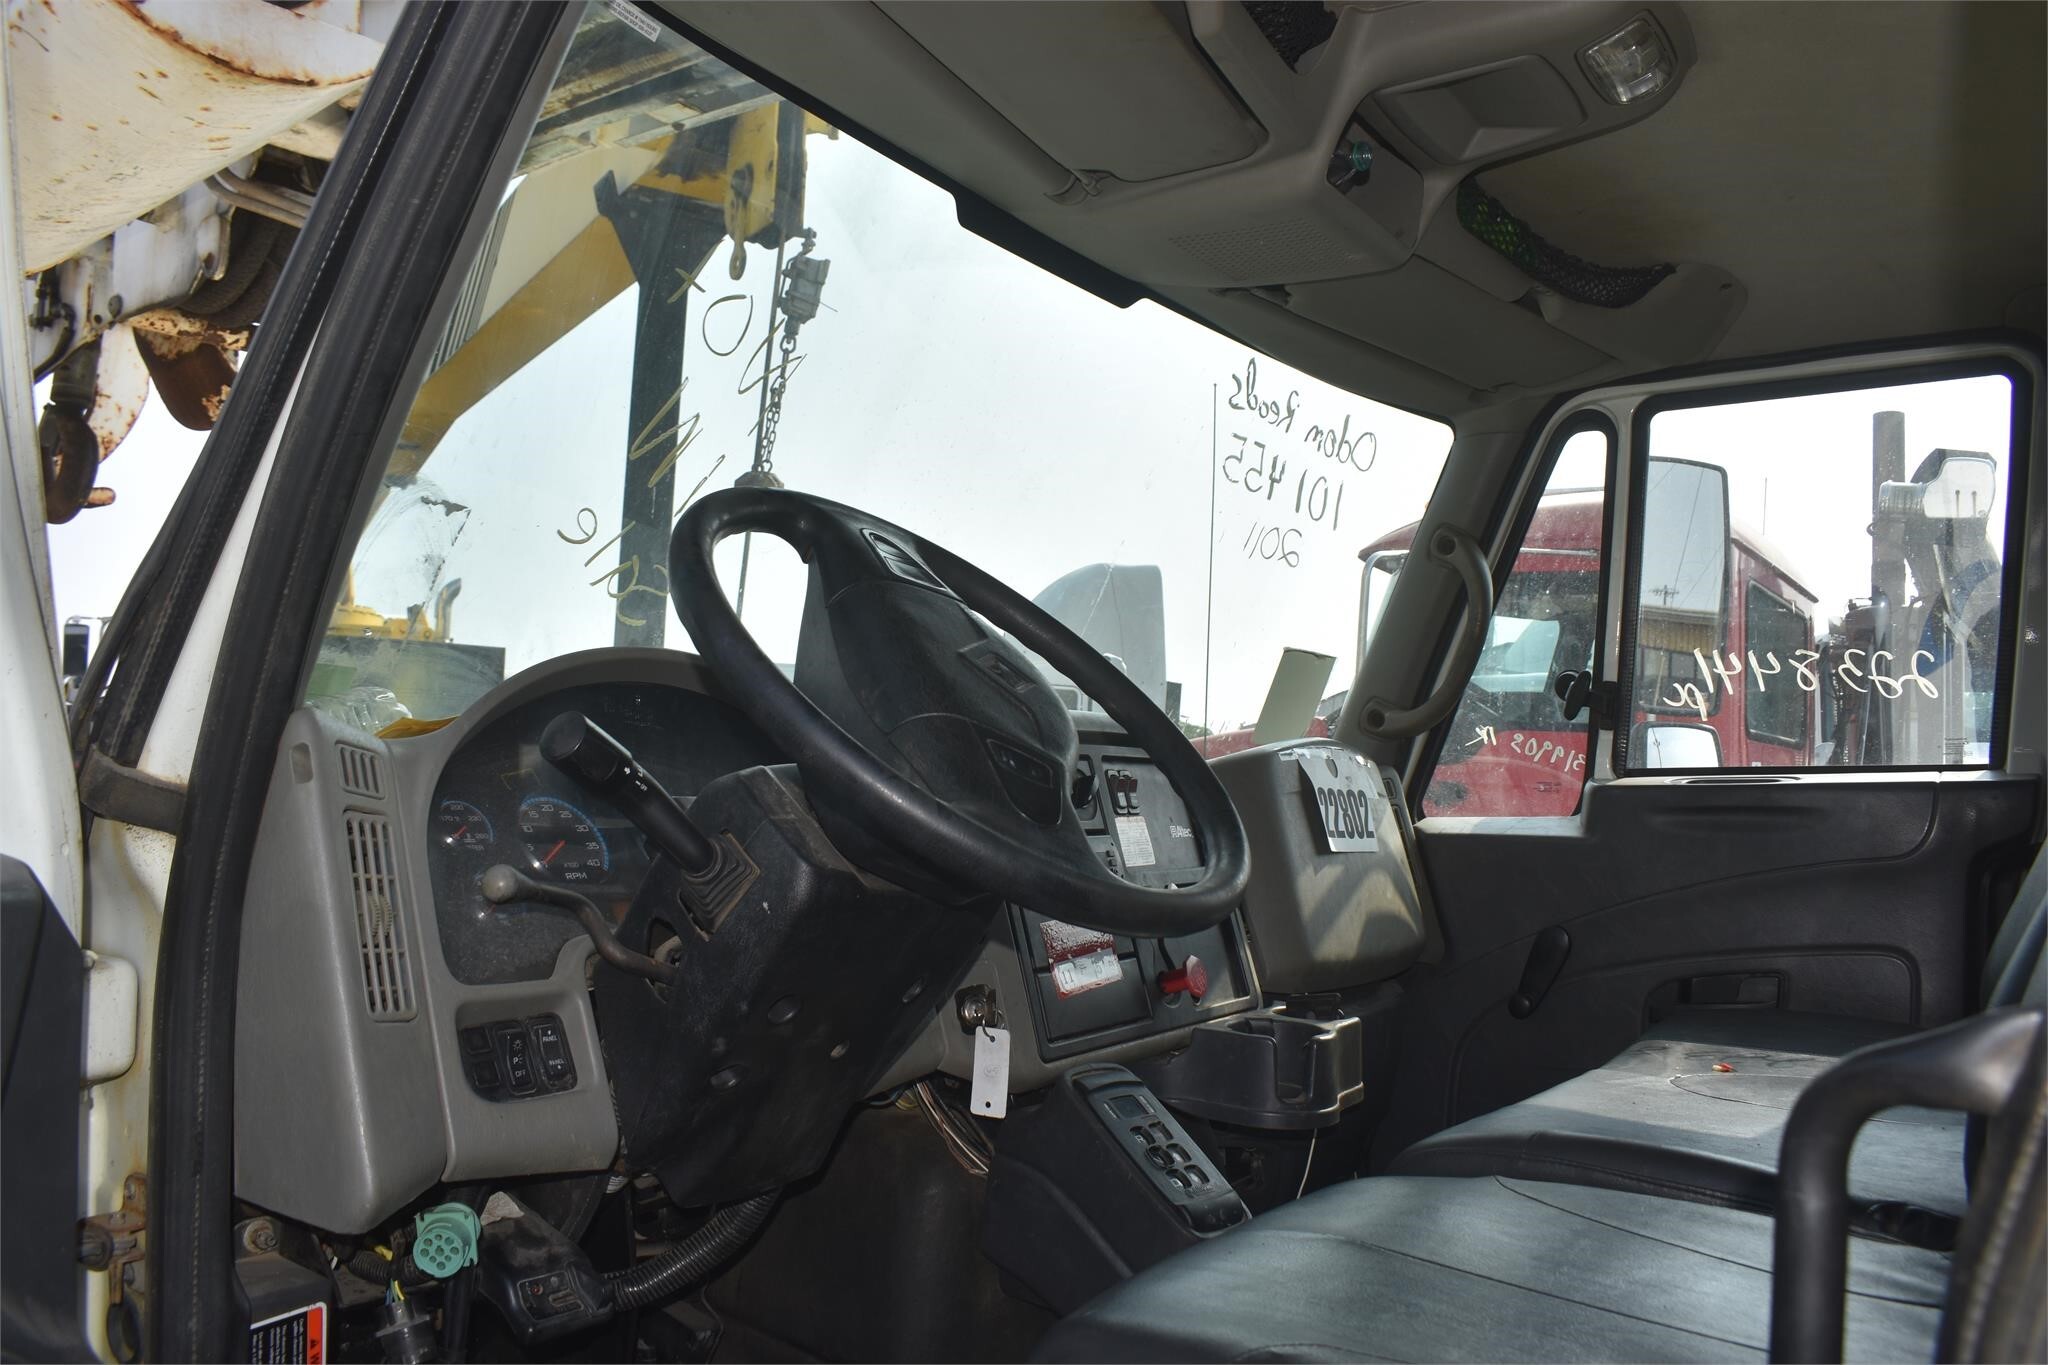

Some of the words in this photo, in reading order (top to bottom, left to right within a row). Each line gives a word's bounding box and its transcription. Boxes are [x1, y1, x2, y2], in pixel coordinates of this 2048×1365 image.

[540, 804, 555, 812] 20
[1317, 787, 1376, 839] 22802
[575, 824, 590, 832] 30
[585, 841, 600, 850] 35
[586, 858, 601, 868] 40
[565, 871, 588, 880] RPM
